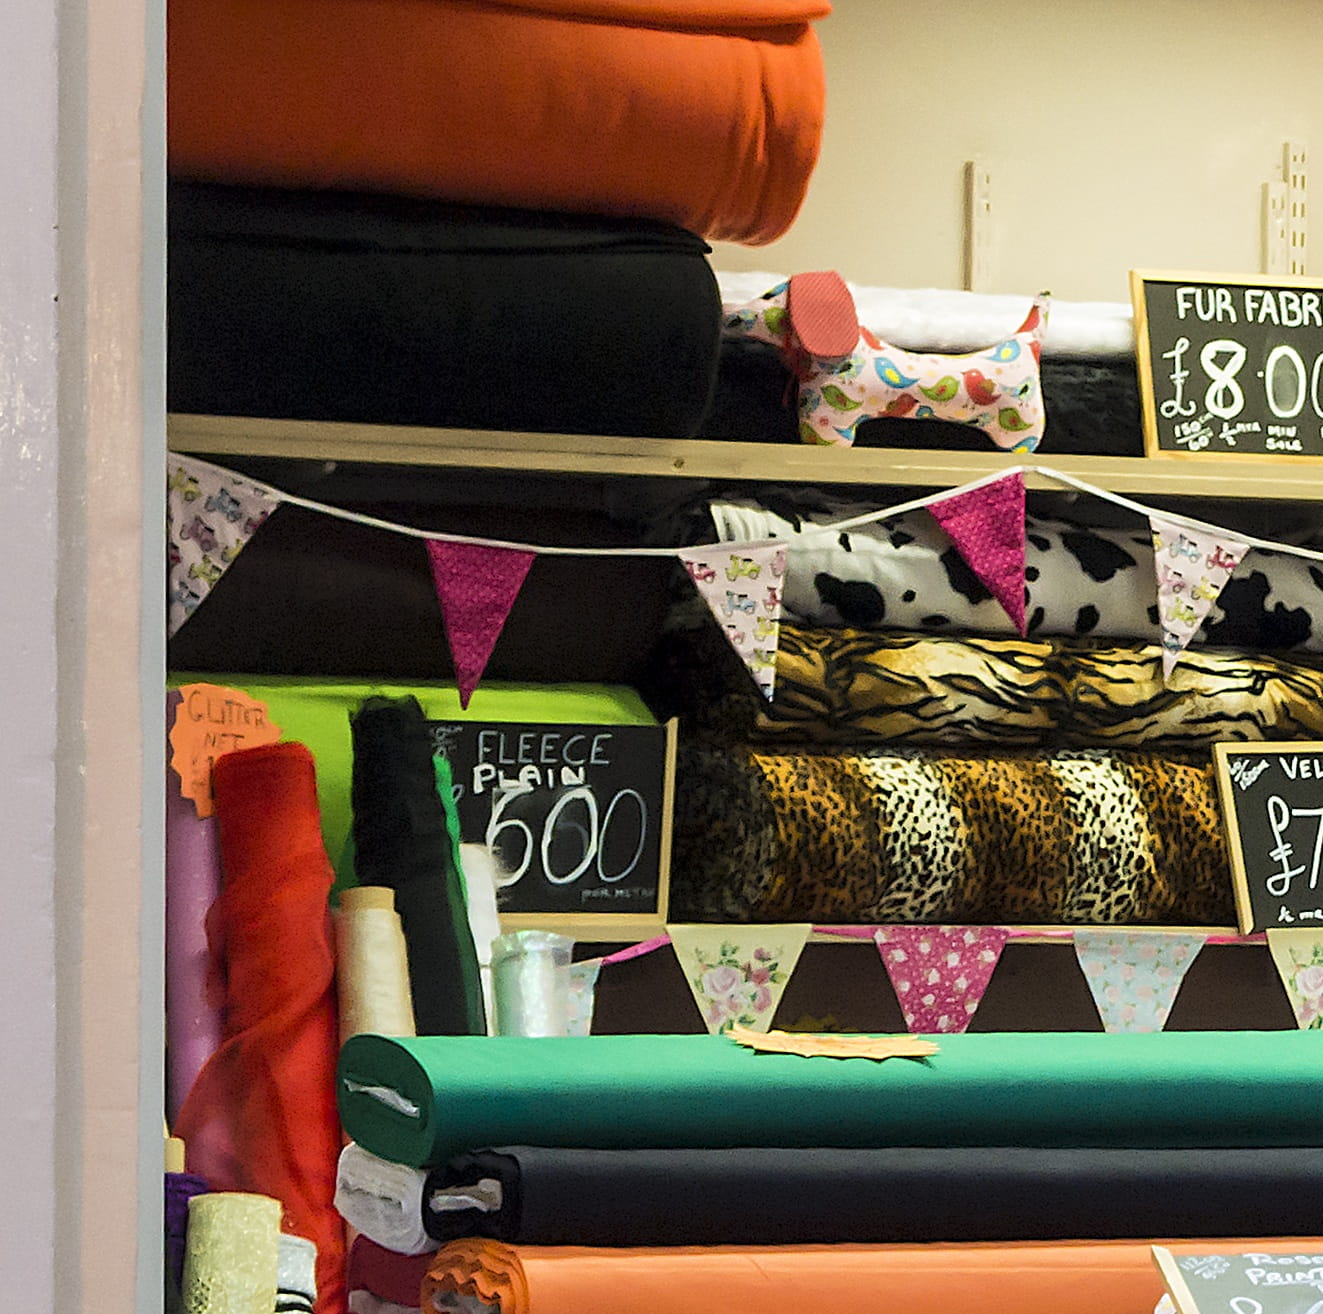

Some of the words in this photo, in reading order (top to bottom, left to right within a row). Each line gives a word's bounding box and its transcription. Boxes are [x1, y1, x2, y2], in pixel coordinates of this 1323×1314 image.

[1176, 287, 1238, 323] FUR
[477, 730, 614, 764] FLEECE
[473, 764, 590, 794] PLAIN
